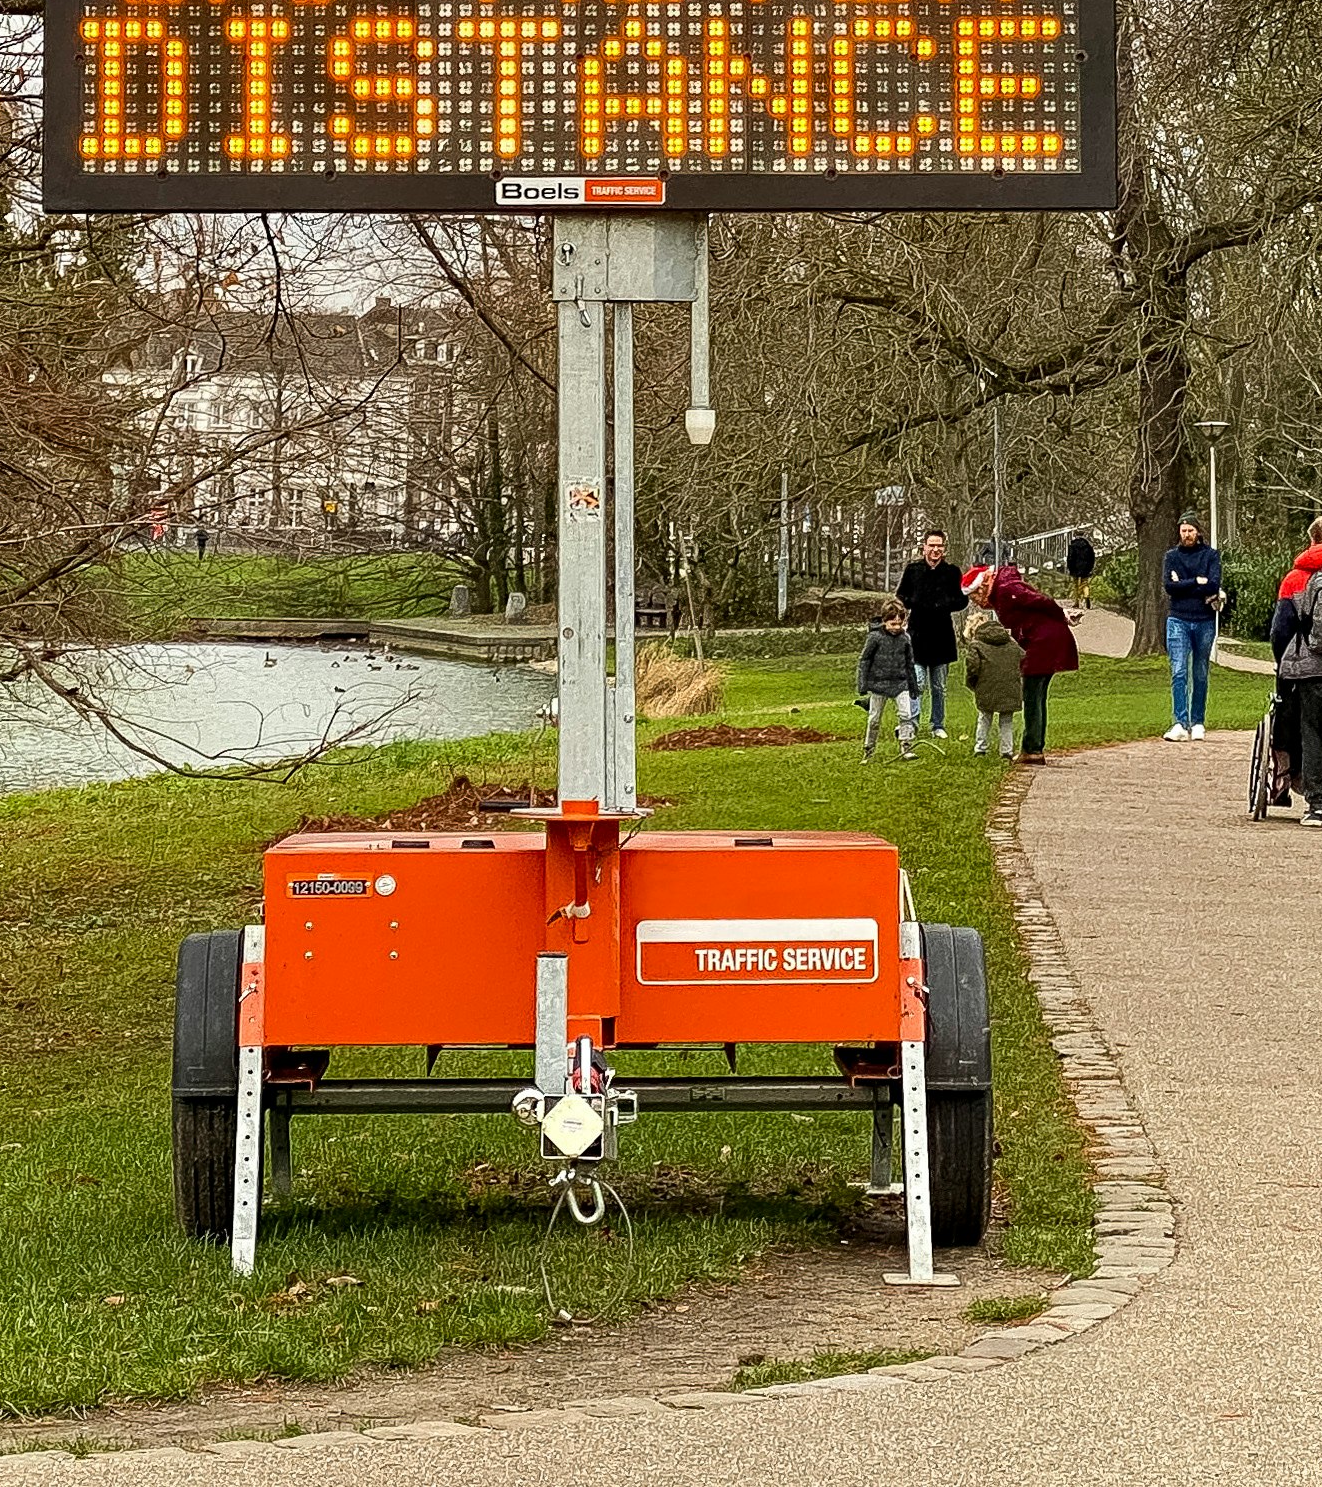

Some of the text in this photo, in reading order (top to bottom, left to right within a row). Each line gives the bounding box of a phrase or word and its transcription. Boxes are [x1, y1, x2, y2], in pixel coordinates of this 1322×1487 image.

[81, 18, 1061, 157] DISTANCE
[501, 183, 579, 199] Boels
[592, 186, 657, 196] TRAFFIC SERVICE
[695, 947, 867, 972] TRAFFIC SERVICE
